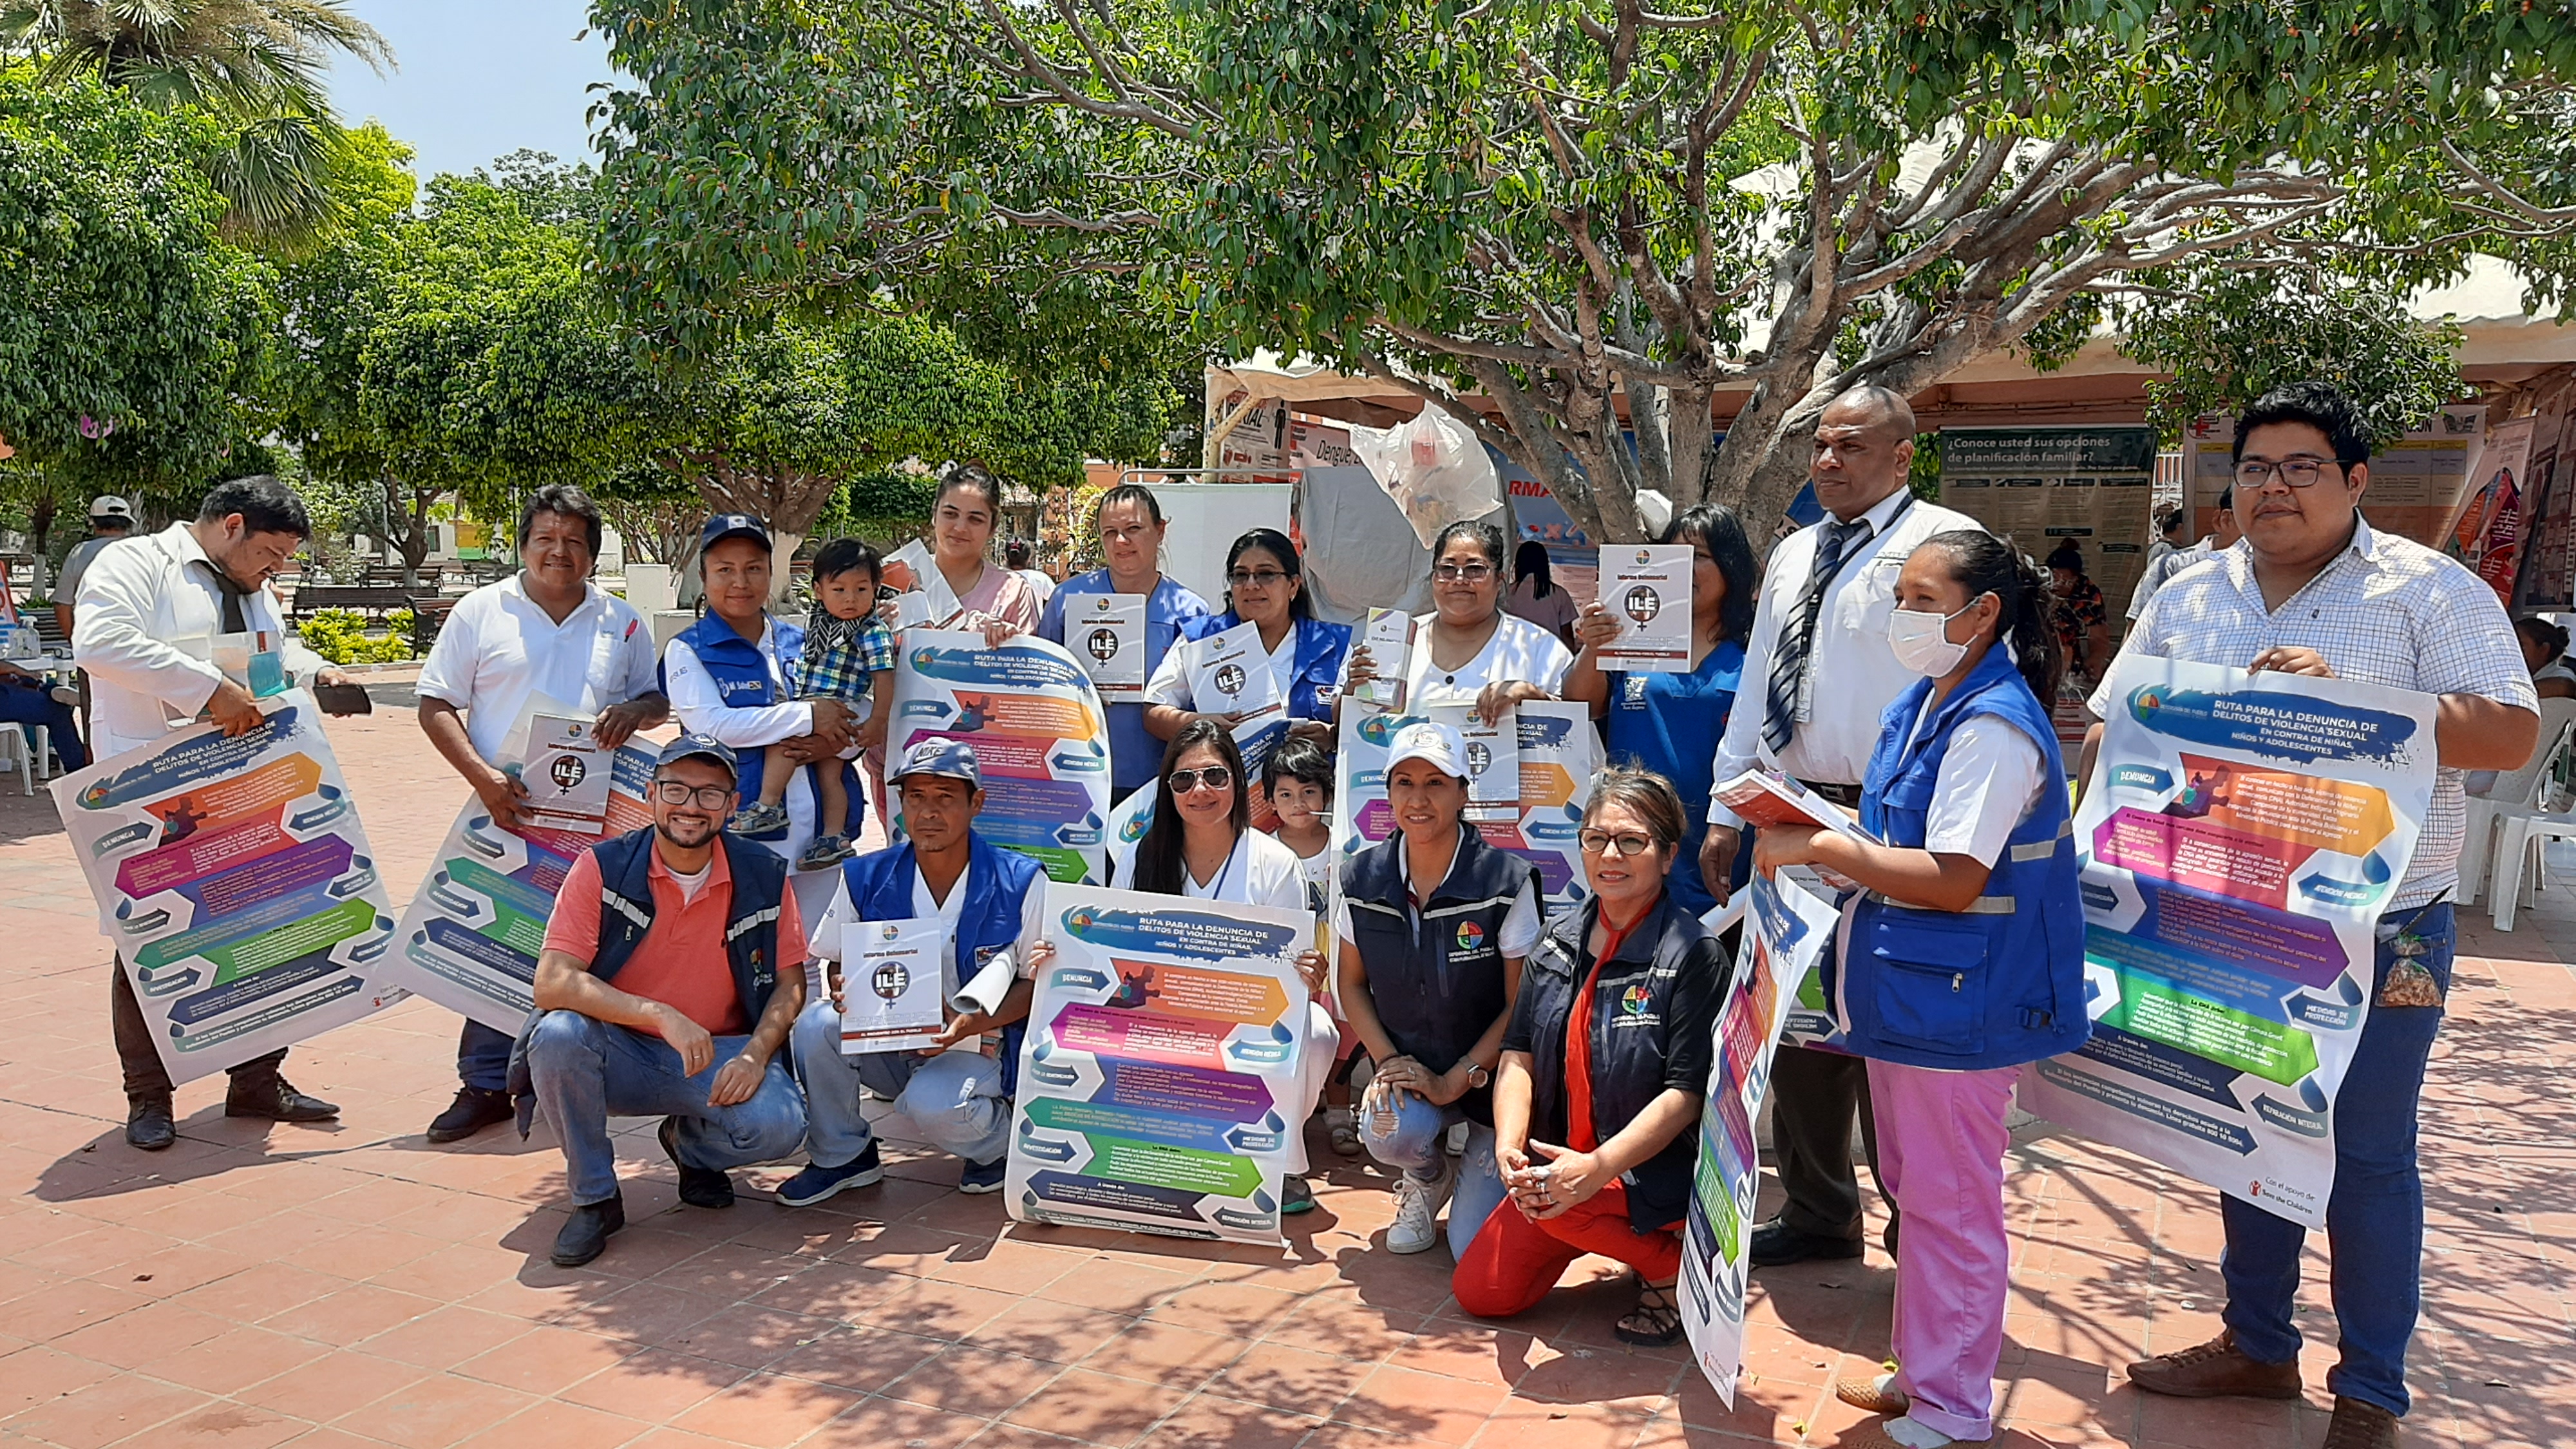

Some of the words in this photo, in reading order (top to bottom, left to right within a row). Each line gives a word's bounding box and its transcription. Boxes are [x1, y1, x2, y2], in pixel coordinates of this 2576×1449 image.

[1947, 438, 1996, 450] ¿Conoce
[1998, 437, 2032, 448] usted
[2034, 439, 2054, 448] sus
[2056, 437, 2110, 450] opciones
[1316, 440, 1352, 468] Dengue,
[1947, 453, 1962, 463] de
[1964, 451, 2039, 465] planificación
[2041, 451, 2094, 462] familiar?
[1628, 596, 1656, 611] ILE
[1091, 638, 1115, 651] ILE
[974, 660, 1002, 668] DELITOS
[1012, 662, 1047, 670] VIOLENCIA
[1027, 657, 1068, 670] DENUNCIA
[1217, 670, 1244, 688] ILE
[2215, 700, 2243, 712] RUTA
[2246, 705, 2276, 716] PARA
[2278, 710, 2293, 719] LA
[2297, 712, 2358, 729] DENUNCIA
[2360, 722, 2378, 732] DE
[2213, 710, 2251, 723] DELITOS
[2254, 716, 2268, 725] DE
[2269, 719, 2325, 734] VIOLENCIA
[2325, 727, 2367, 741] SEXUAL
[2260, 727, 2272, 735] EN
[2273, 730, 2307, 741] CONTRA
[152, 754, 177, 768] RUTA
[178, 745, 204, 759] PARA
[205, 741, 217, 751] LA
[218, 725, 265, 746] DENUNCIA
[264, 720, 276, 729] DE
[1238, 737, 1265, 757] NUNCIA
[1264, 731, 1275, 741] DE
[2231, 731, 2257, 742] NIÑOS
[2264, 737, 2332, 754] ADOLESCENTES
[155, 757, 189, 773] DELITOS
[189, 753, 202, 762] DE
[204, 739, 245, 757] VIOLENCIA
[209, 748, 237, 762] CONTRA
[915, 746, 943, 759] NIKE
[1468, 752, 1488, 766] LE
[622, 753, 645, 768] PARA
[627, 762, 638, 772] DE
[554, 764, 582, 779] ILE
[2120, 771, 2155, 784] DENUNCIA
[1139, 917, 1163, 926] RUTA
[1164, 920, 1190, 929] PARA
[1206, 925, 1253, 937] DENUNCIA
[1139, 924, 1171, 934] DELITOS
[1186, 930, 1229, 941] VIOLENCIA
[1230, 936, 1261, 945] SEXUAL
[1189, 938, 1217, 946] CONTRA
[1184, 944, 1236, 956] ADOLESCENTES
[876, 971, 906, 989] ILE
[2285, 1199, 2314, 1215] Children
